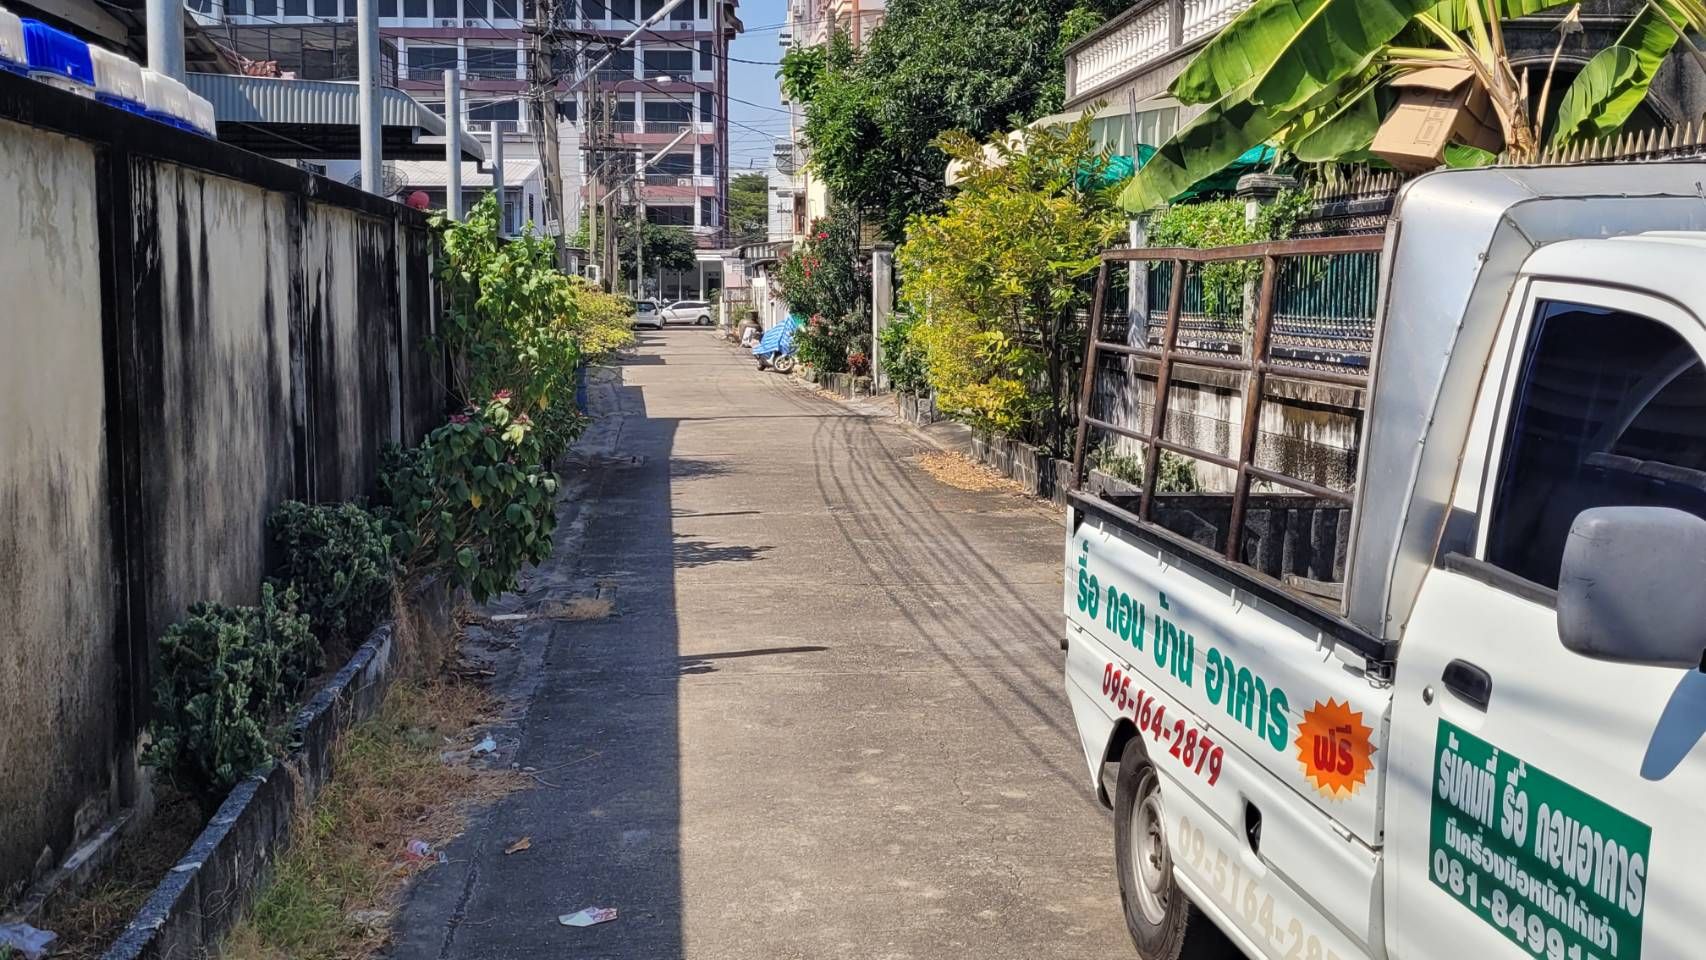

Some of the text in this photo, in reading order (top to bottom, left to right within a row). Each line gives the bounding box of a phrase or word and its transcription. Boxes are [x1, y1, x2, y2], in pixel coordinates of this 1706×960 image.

[1077, 540, 1290, 752] รื้อ ถอน บ้าน อาคาร
[1102, 663, 1225, 786] 095-164-2879
[1313, 724, 1354, 776] ฟรี
[1178, 815, 1341, 960] 09-5164-28
[1439, 731, 1645, 917] รับถมที่ รื้อ ถอนอาคาร
[1445, 817, 1618, 958] มีเครื่องมือหนักให้เช่า
[1434, 848, 1602, 960] 081-8499
